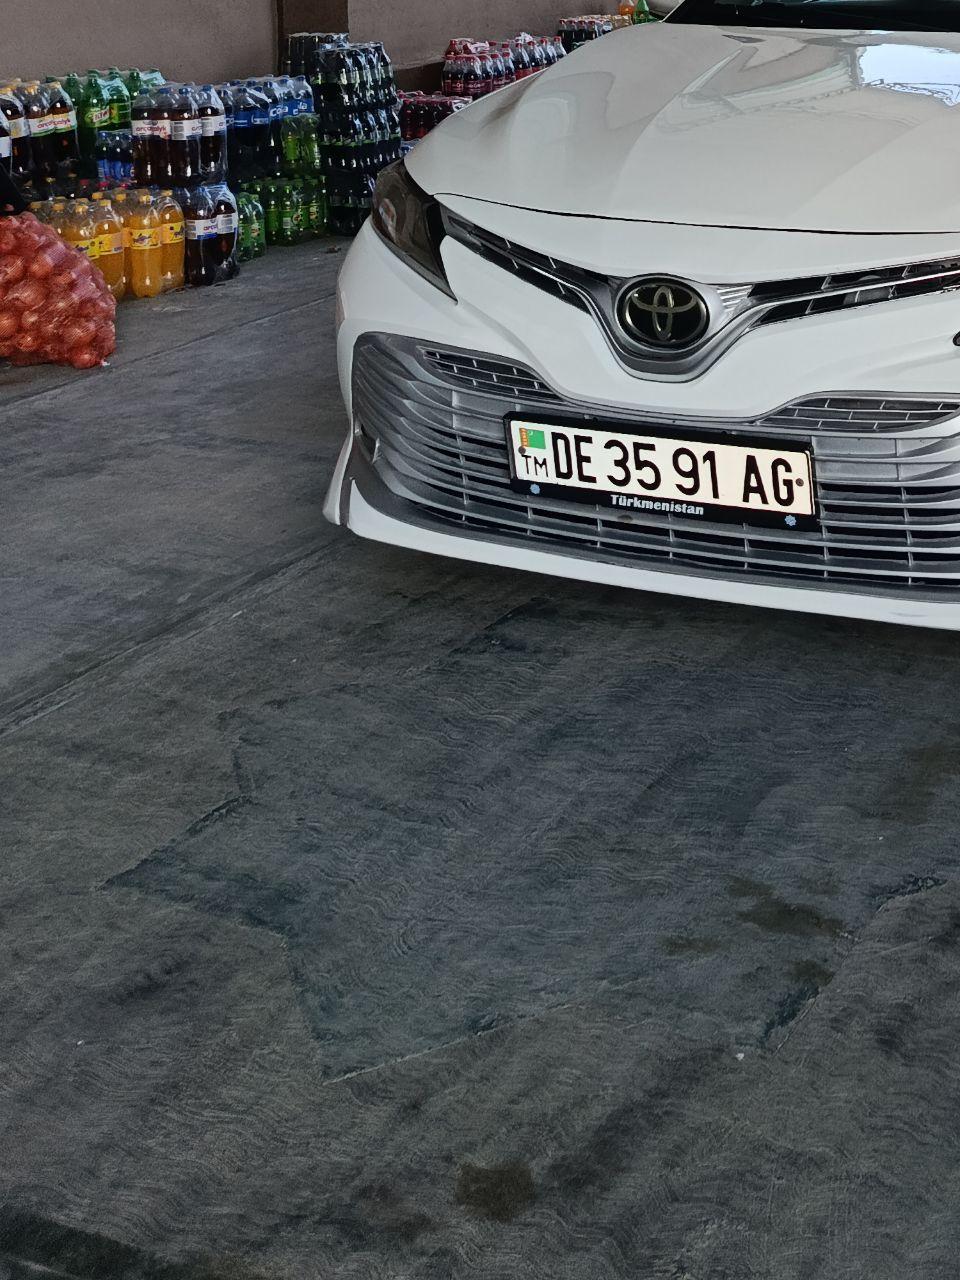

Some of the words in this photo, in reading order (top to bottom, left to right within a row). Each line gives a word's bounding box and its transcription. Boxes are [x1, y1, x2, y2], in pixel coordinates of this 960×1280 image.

[521, 454, 549, 477] TM
[743, 455, 795, 506] AG
[610, 494, 704, 515] Türkmenistan
